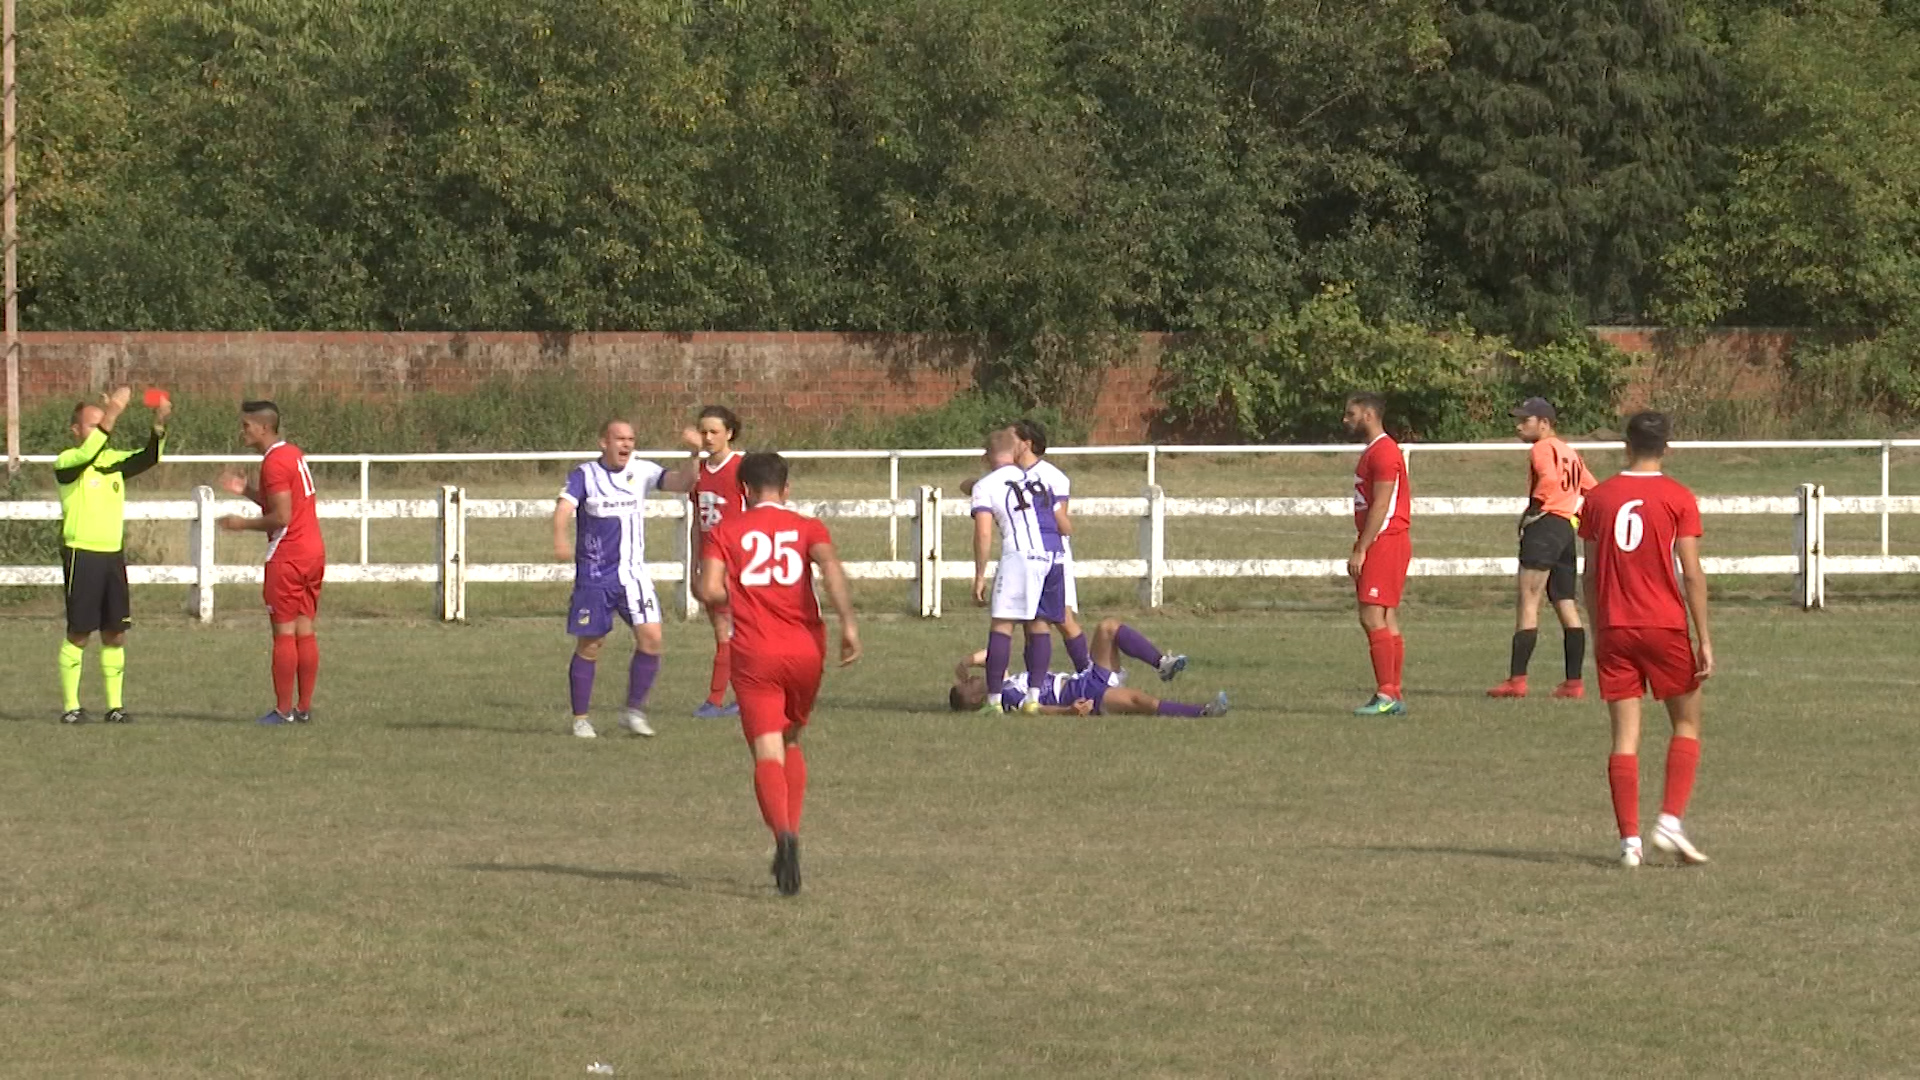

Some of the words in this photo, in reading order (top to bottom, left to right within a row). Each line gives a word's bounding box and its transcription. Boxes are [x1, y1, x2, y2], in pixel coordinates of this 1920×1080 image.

[1561, 457, 1581, 493] 50
[1614, 499, 1644, 553] 6
[740, 530, 804, 587] 25
